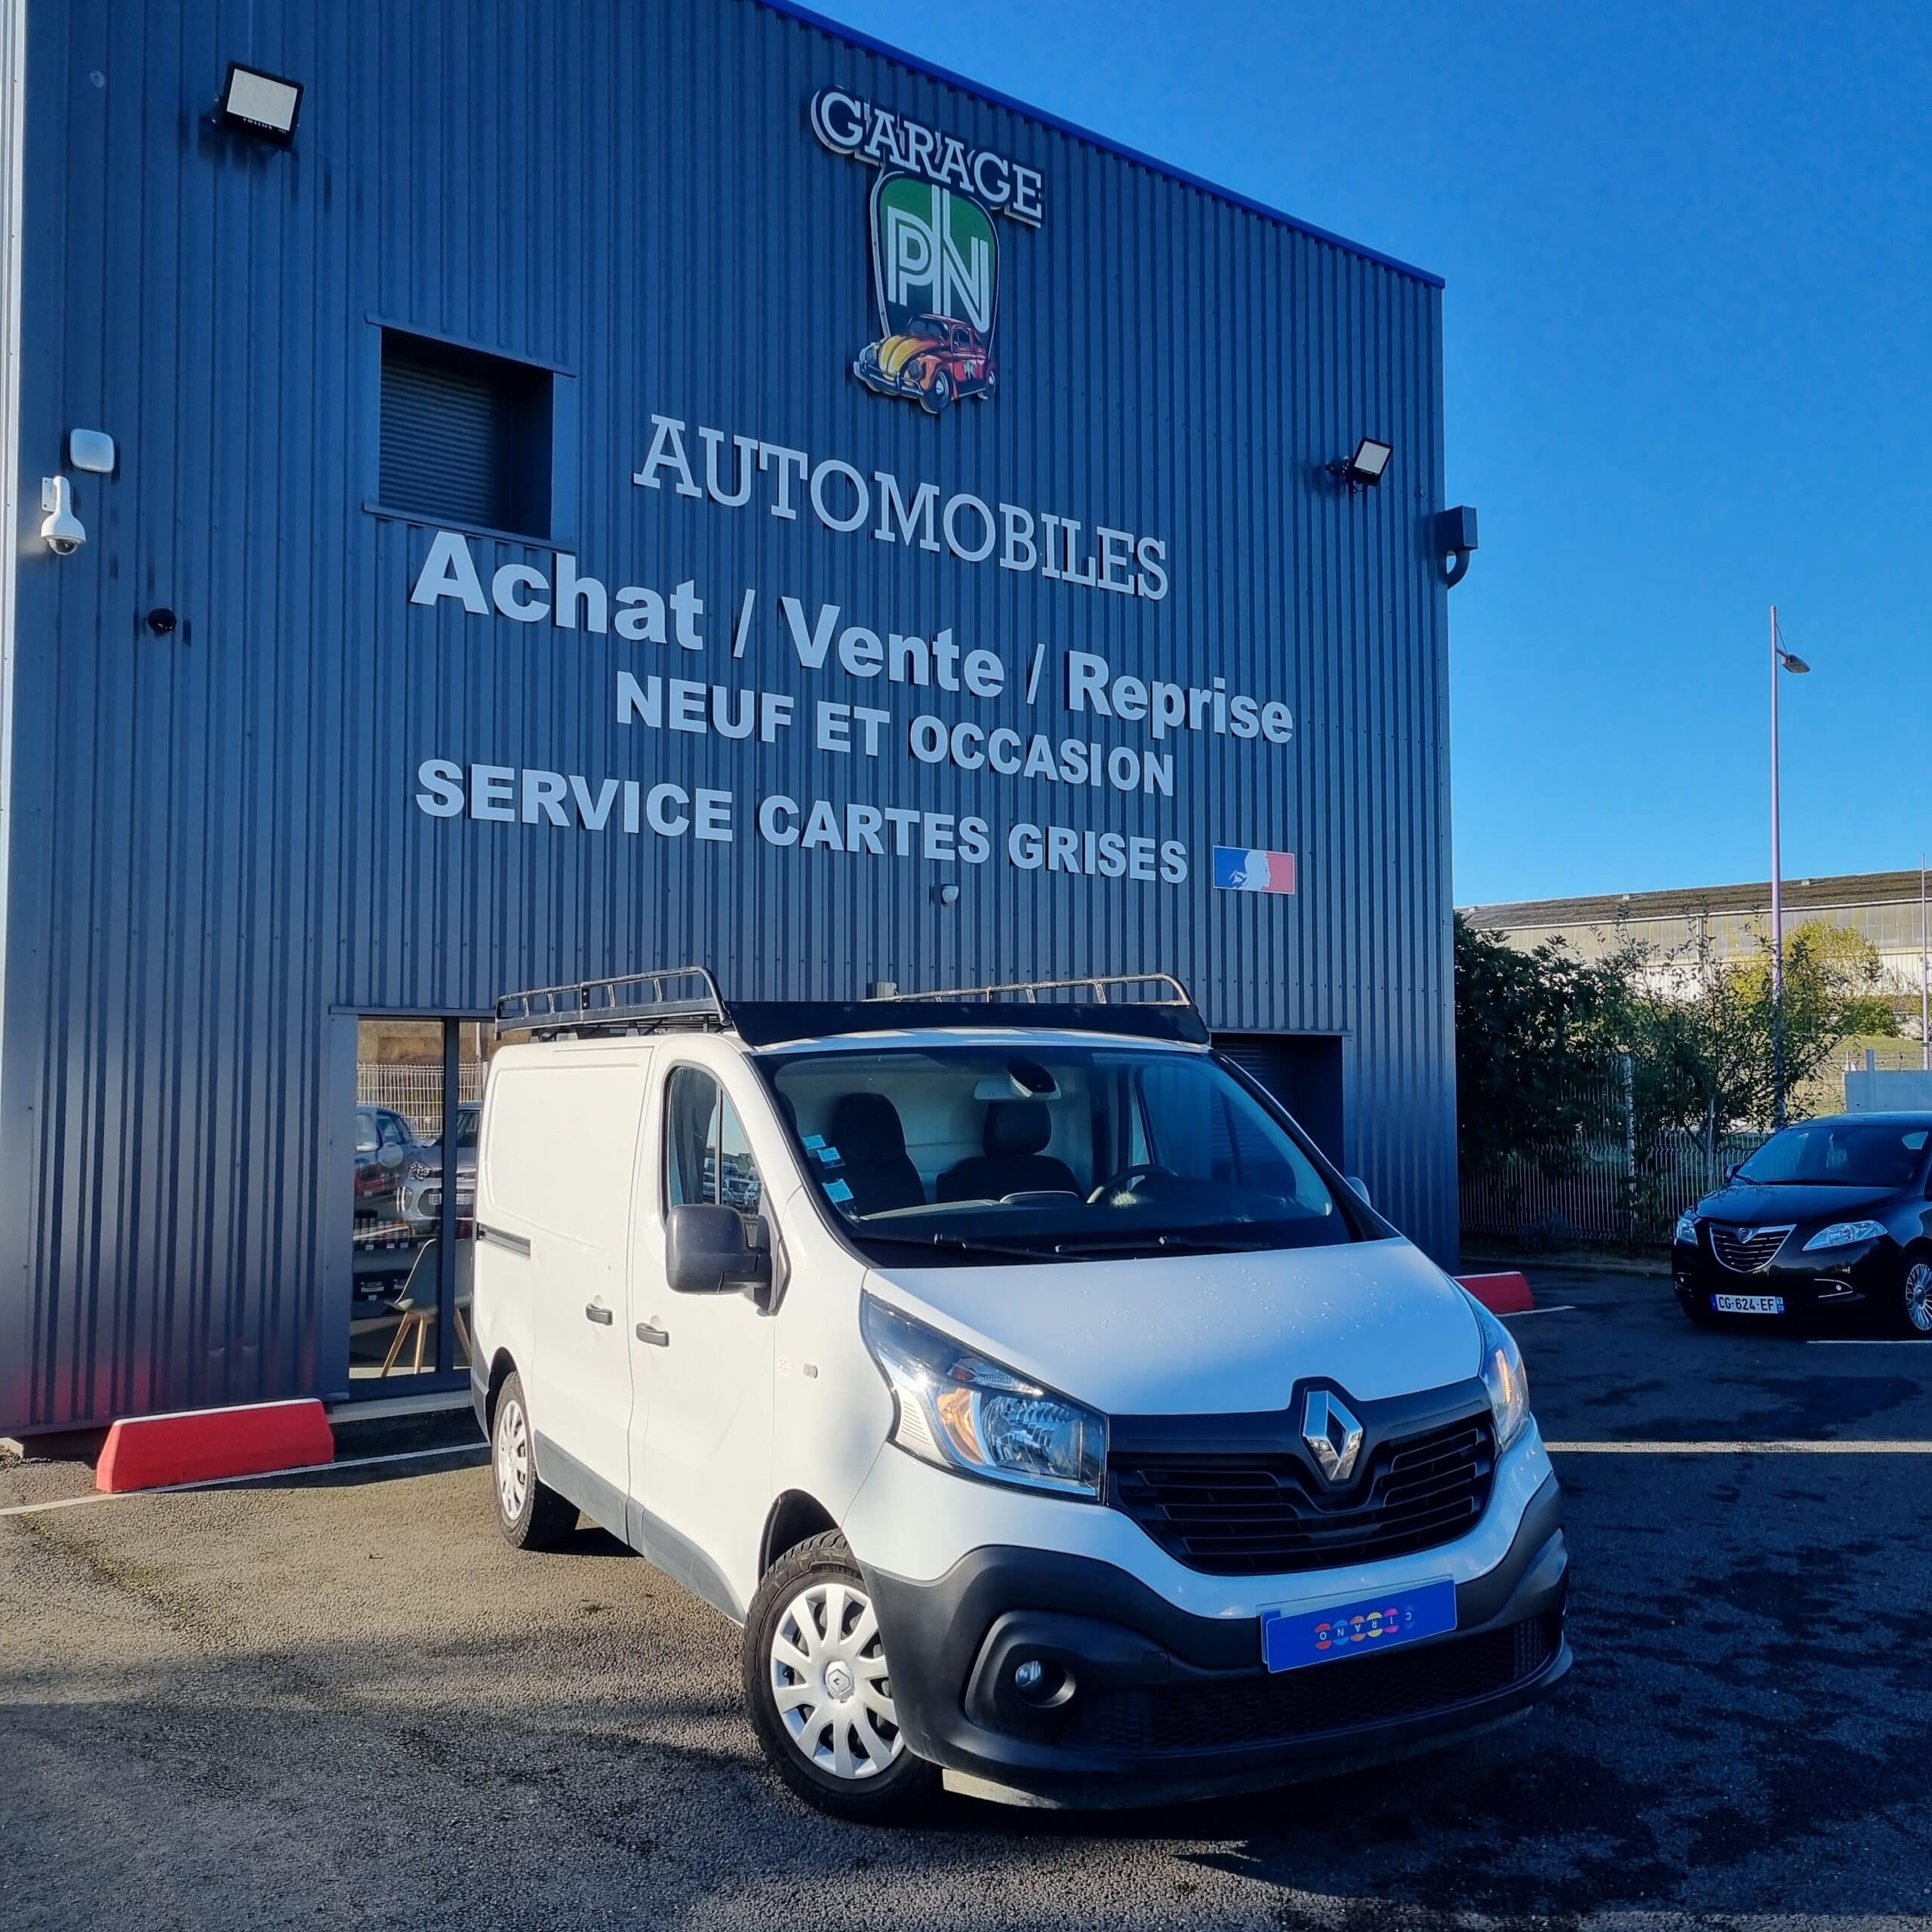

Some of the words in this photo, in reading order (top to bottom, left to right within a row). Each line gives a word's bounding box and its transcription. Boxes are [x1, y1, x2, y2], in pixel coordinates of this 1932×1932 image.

[820, 91, 1043, 221] GARAGE
[633, 413, 1169, 601] AUTOMOBILES
[410, 530, 704, 651] Achat
[733, 589, 756, 658] /
[780, 595, 1005, 697] Vente
[1026, 643, 1046, 705] /
[1069, 650, 1294, 744] Reprise
[617, 670, 794, 743] NEUF
[817, 700, 891, 756] ET
[910, 715, 1173, 797] OCCASION
[415, 758, 733, 842] SERVICE
[759, 795, 990, 863] CARTES
[1008, 823, 1187, 884] GRISES
[1718, 1297, 1774, 1312] CG-624-EF
[1318, 1611, 1412, 1641] CIRANO
